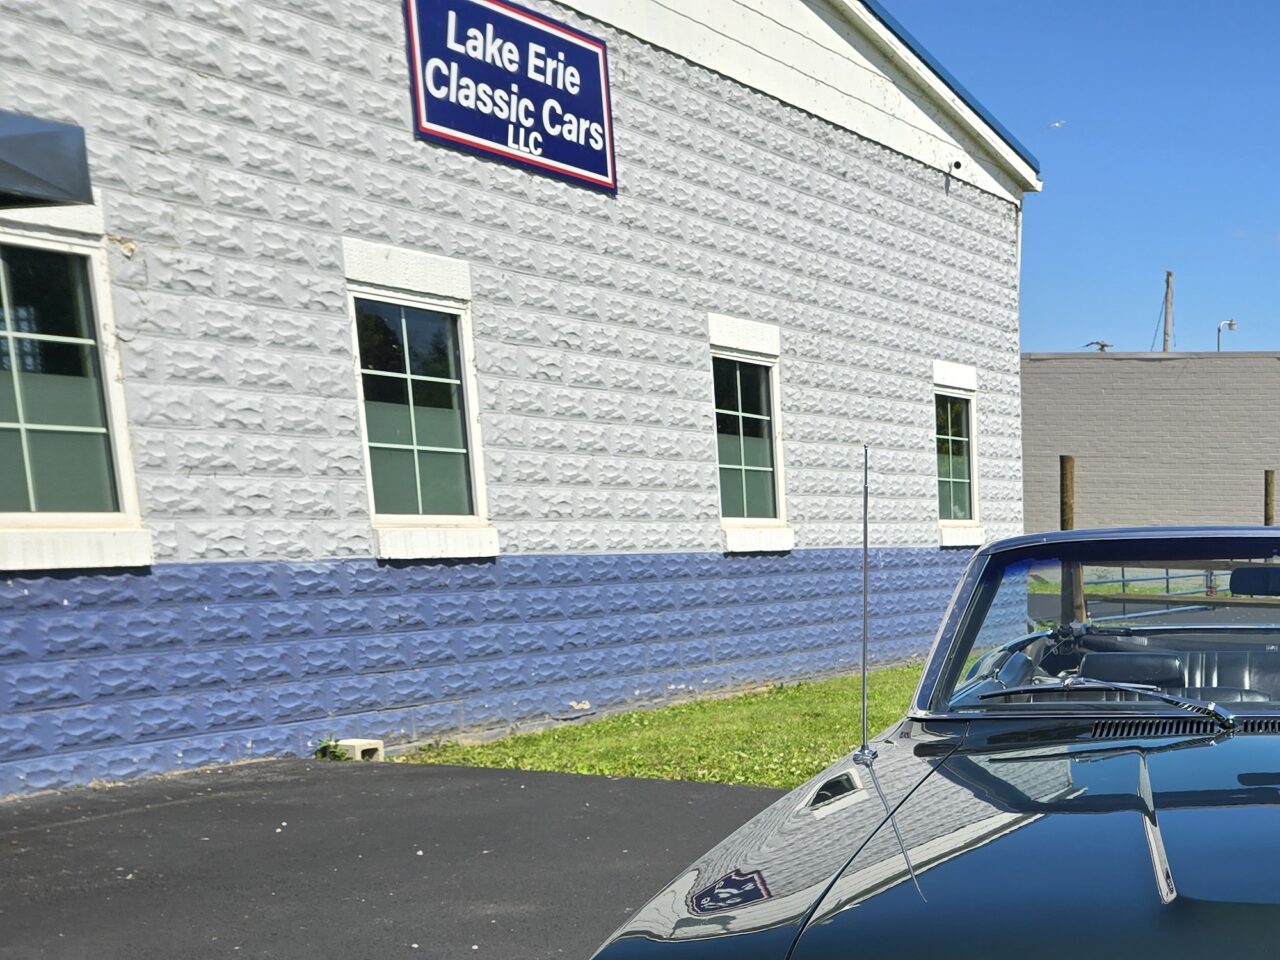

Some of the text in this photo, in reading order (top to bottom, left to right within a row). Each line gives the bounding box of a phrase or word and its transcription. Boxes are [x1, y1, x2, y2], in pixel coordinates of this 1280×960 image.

[446, 10, 581, 95] Lake Erie
[424, 57, 604, 151] Classic Cars
[507, 124, 543, 156] LLC
